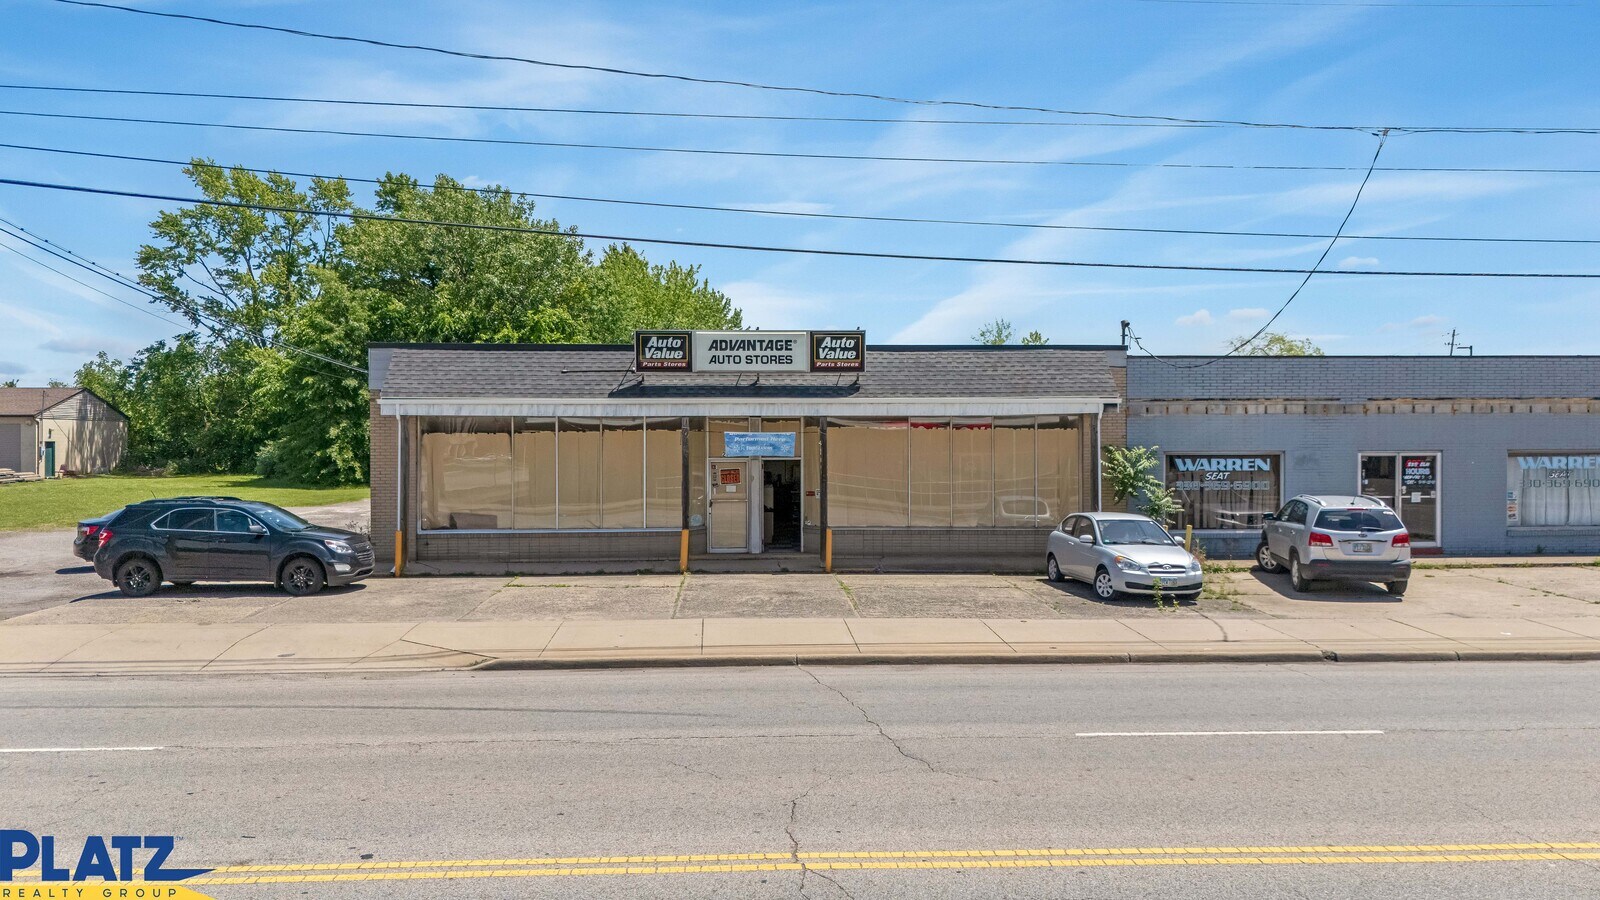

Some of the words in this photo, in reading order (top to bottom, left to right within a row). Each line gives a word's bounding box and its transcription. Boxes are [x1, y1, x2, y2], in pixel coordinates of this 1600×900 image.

[646, 336, 682, 348] Auto
[708, 339, 793, 352] ADVANTAGE
[820, 336, 855, 348] Auto
[644, 347, 684, 359] Value
[818, 347, 857, 359] Value
[708, 354, 742, 365] AUTO
[745, 354, 793, 365] STORES
[1174, 458, 1271, 471] WARREN
[1205, 472, 1231, 481] SEAT
